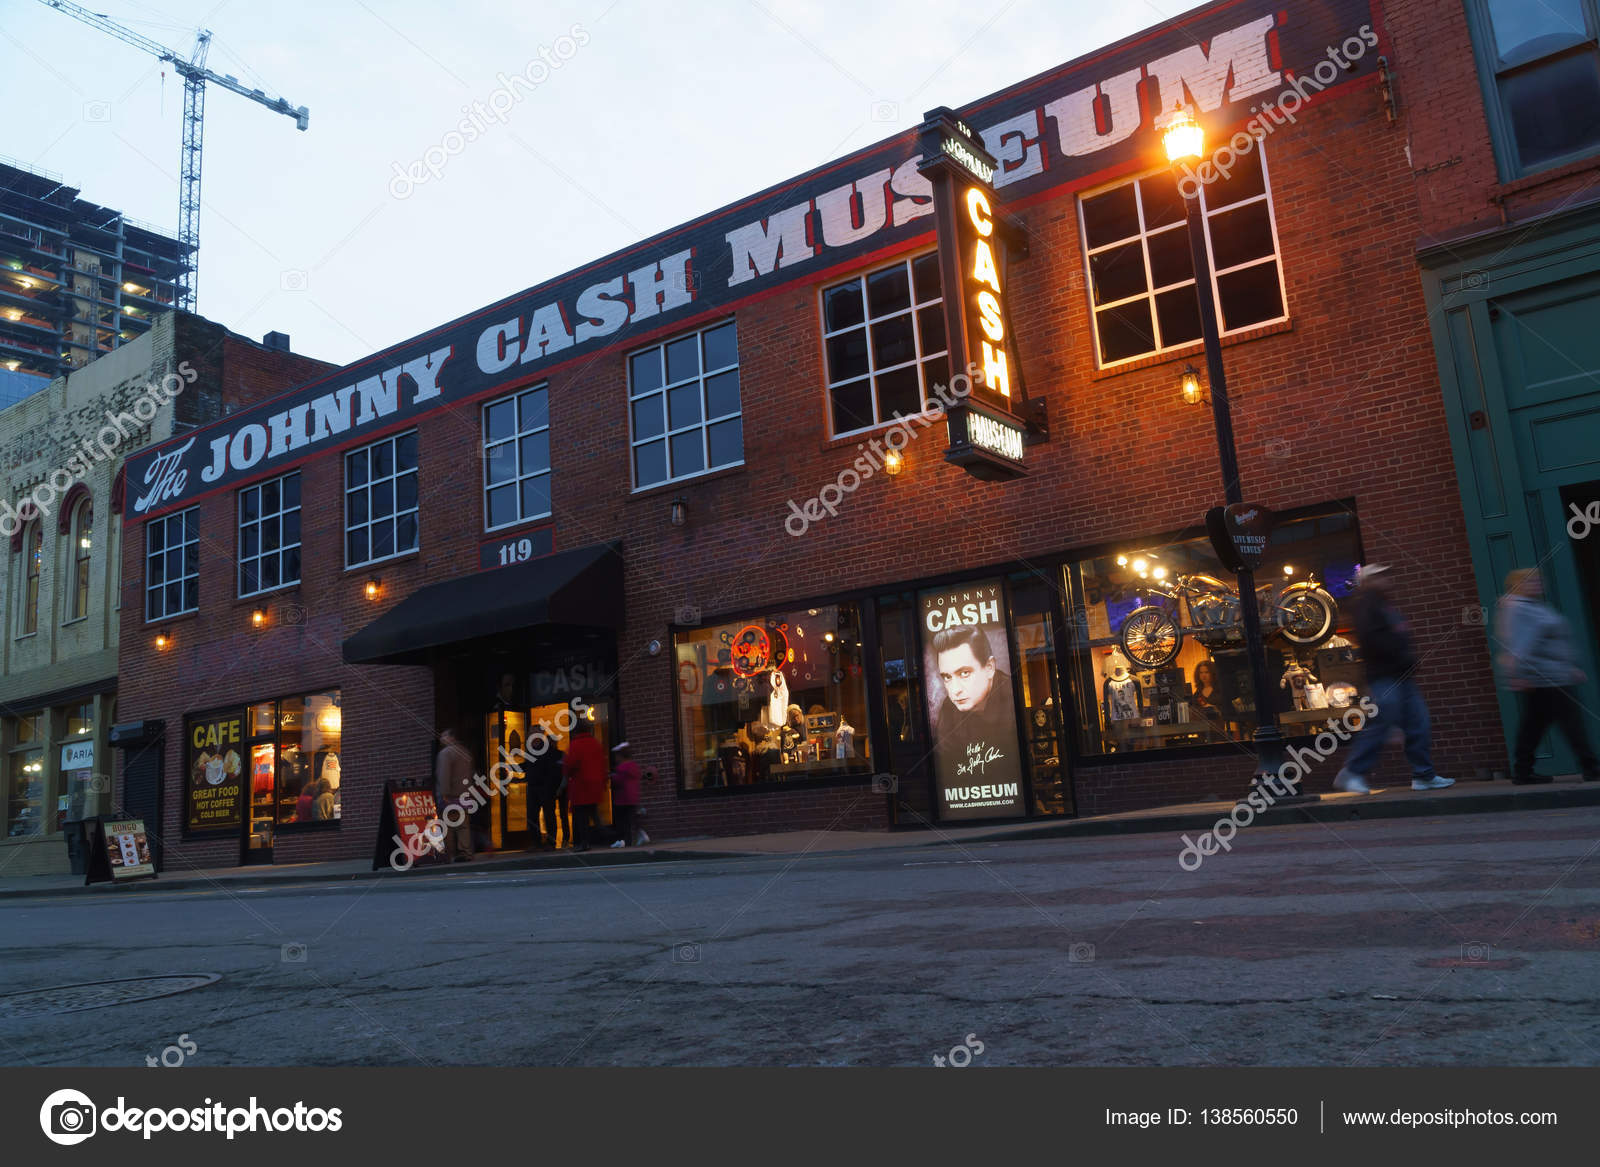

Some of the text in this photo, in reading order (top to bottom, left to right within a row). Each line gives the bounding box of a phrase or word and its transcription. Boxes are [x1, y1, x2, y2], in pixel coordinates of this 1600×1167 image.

[134, 14, 1282, 513] The JOHNNY CASH MUSEUM
[966, 187, 1011, 398] CASH
[967, 411, 1023, 461] MUSEUM
[499, 538, 533, 566] 119
[926, 588, 997, 608] JOHNNY
[926, 600, 999, 632] CASH
[193, 720, 240, 749] CAFE
[73, 748, 93, 760] ARIA
[192, 785, 239, 800] GREAT FOOD
[395, 795, 434, 809] CASH
[944, 783, 1018, 802] MUSEUM
[196, 798, 235, 811] HOT COFFEE
[398, 807, 436, 818] MUSEUM
[949, 799, 1015, 809] WWW.CASHMUSEUM.COM
[112, 824, 137, 833] BONGO
